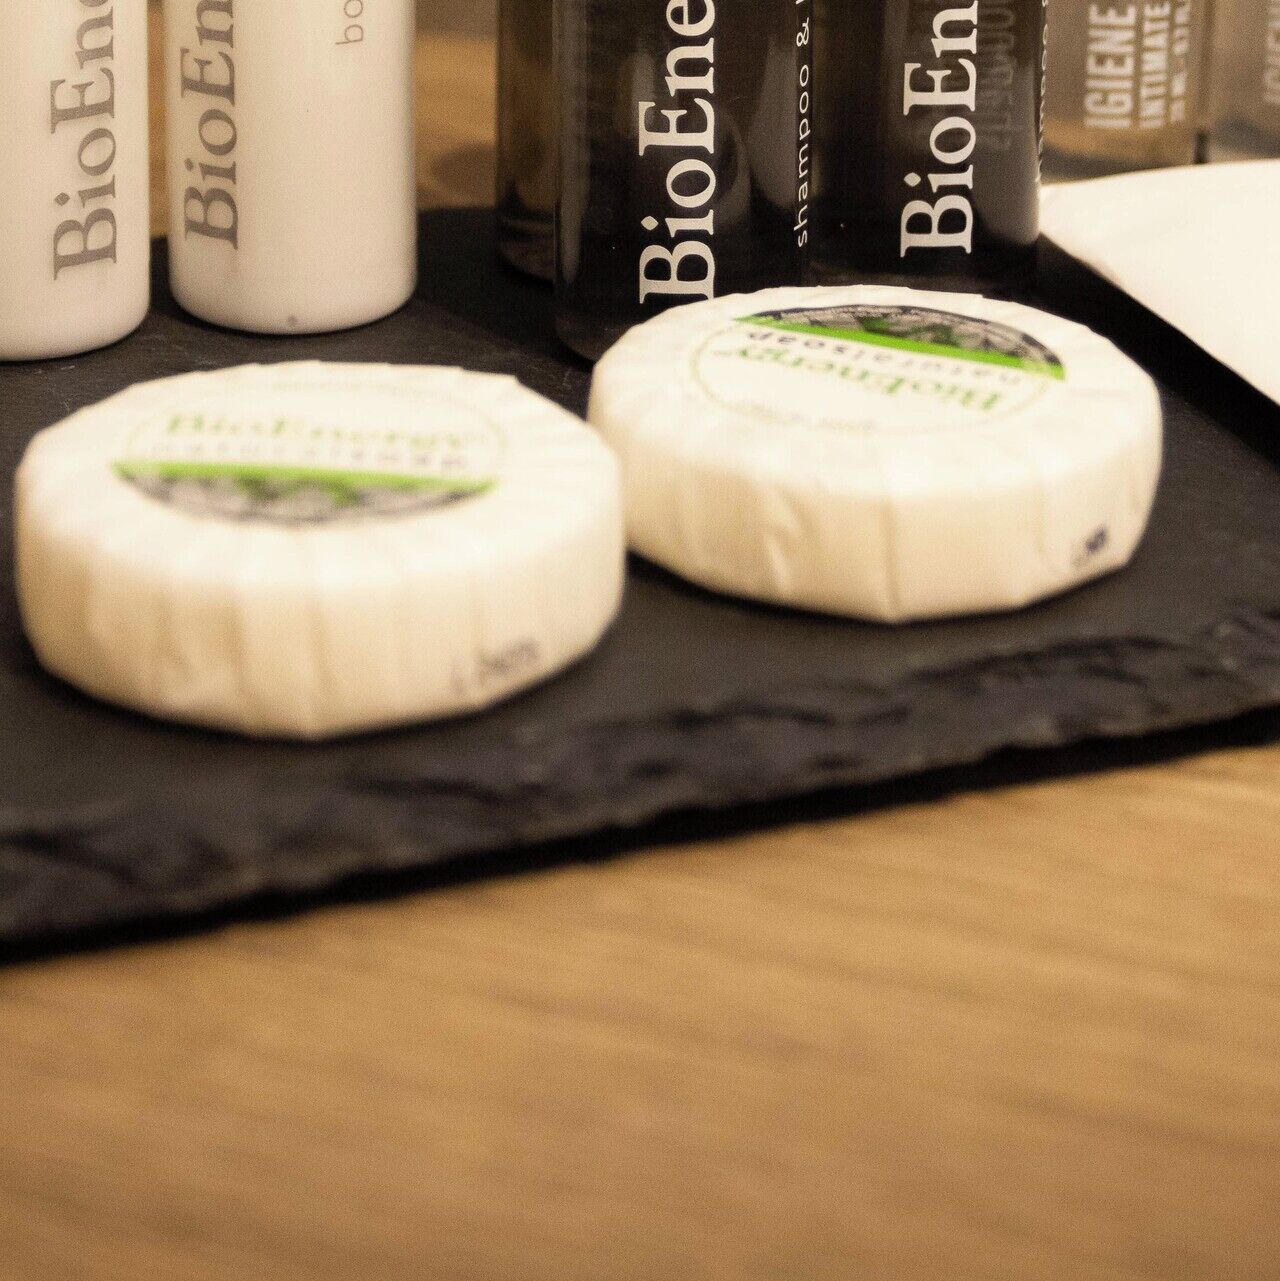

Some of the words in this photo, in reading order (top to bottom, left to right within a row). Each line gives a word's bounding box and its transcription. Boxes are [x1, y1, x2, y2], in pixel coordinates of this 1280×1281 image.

[795, 16, 811, 47] &
[1083, 4, 1137, 130] IGIENE
[1138, 0, 1171, 130] INTIMATE
[794, 64, 811, 249] shampoo
